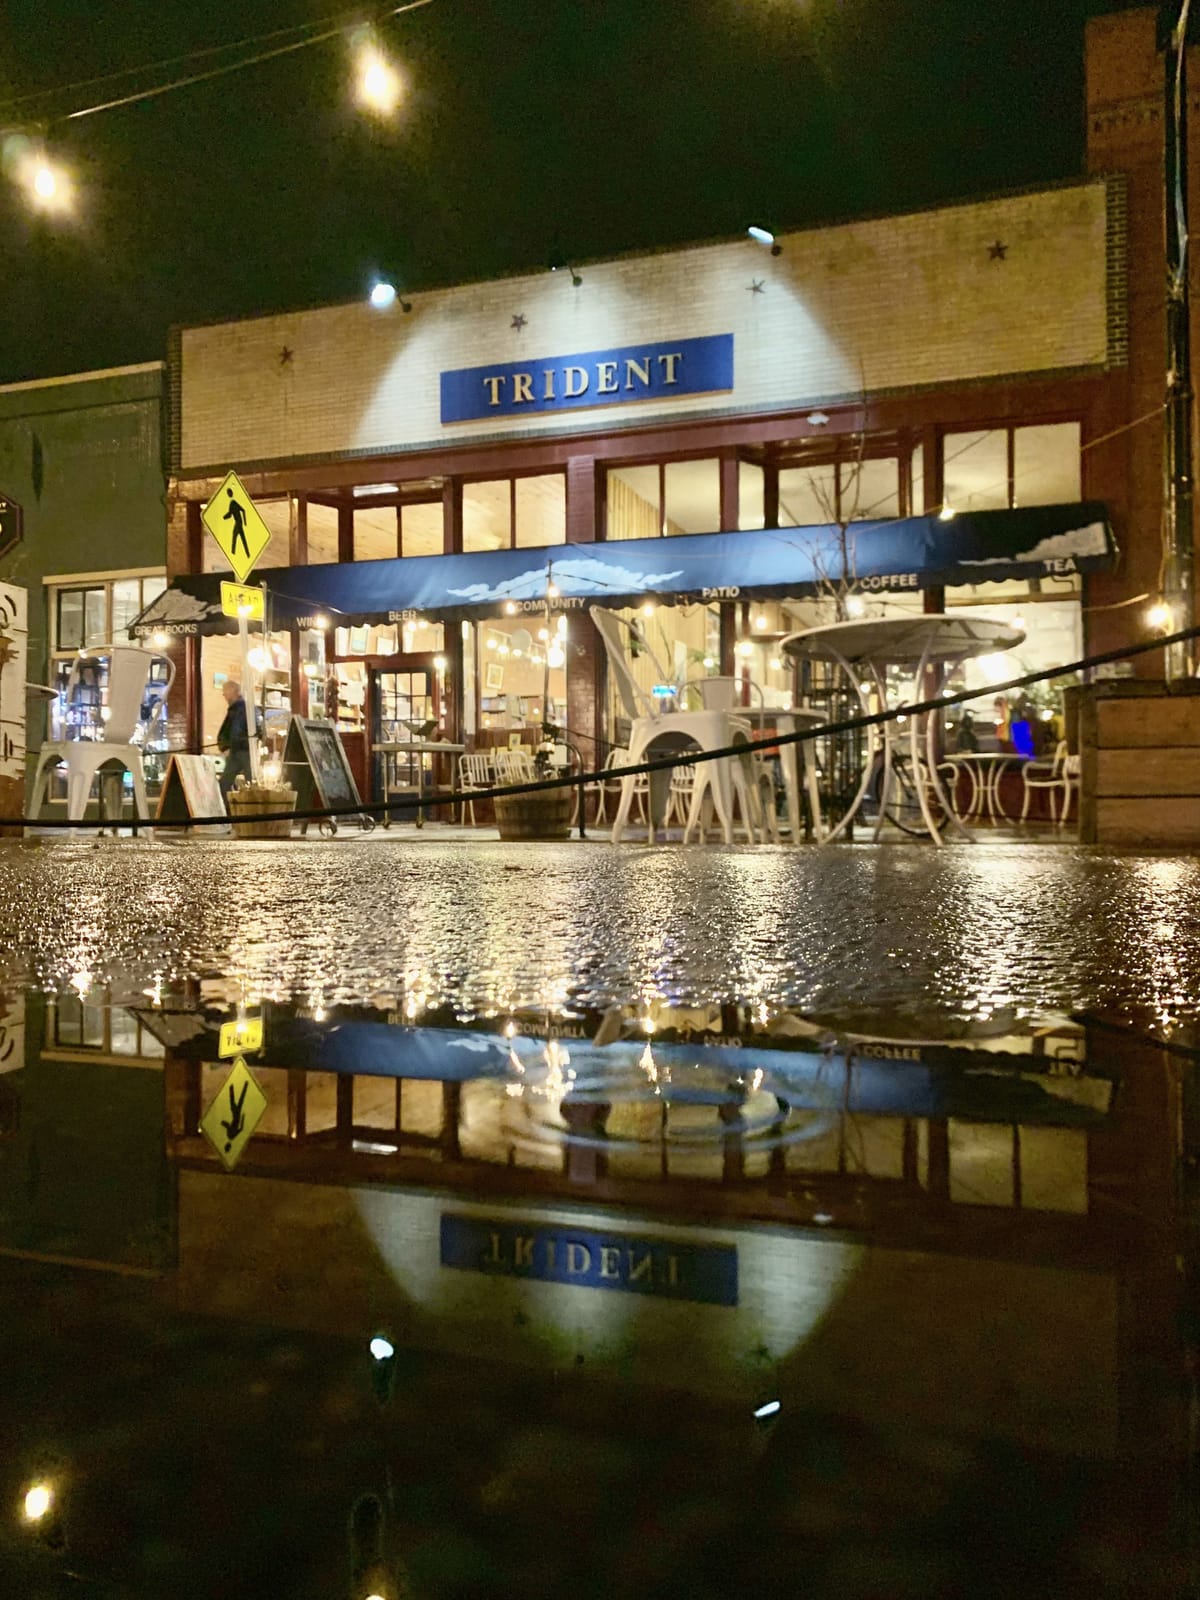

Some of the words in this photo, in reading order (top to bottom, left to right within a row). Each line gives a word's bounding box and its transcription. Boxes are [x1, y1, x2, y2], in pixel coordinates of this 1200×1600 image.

[484, 353, 682, 406] TRIDENT
[1043, 558, 1076, 572] TEA
[860, 573, 919, 589] COFFEE
[702, 586, 740, 598] PATIO
[516, 598, 585, 611] COMMUNITY
[388, 610, 417, 621] BEER
[134, 624, 163, 636] GREAT
[165, 623, 198, 634] BOOKS
